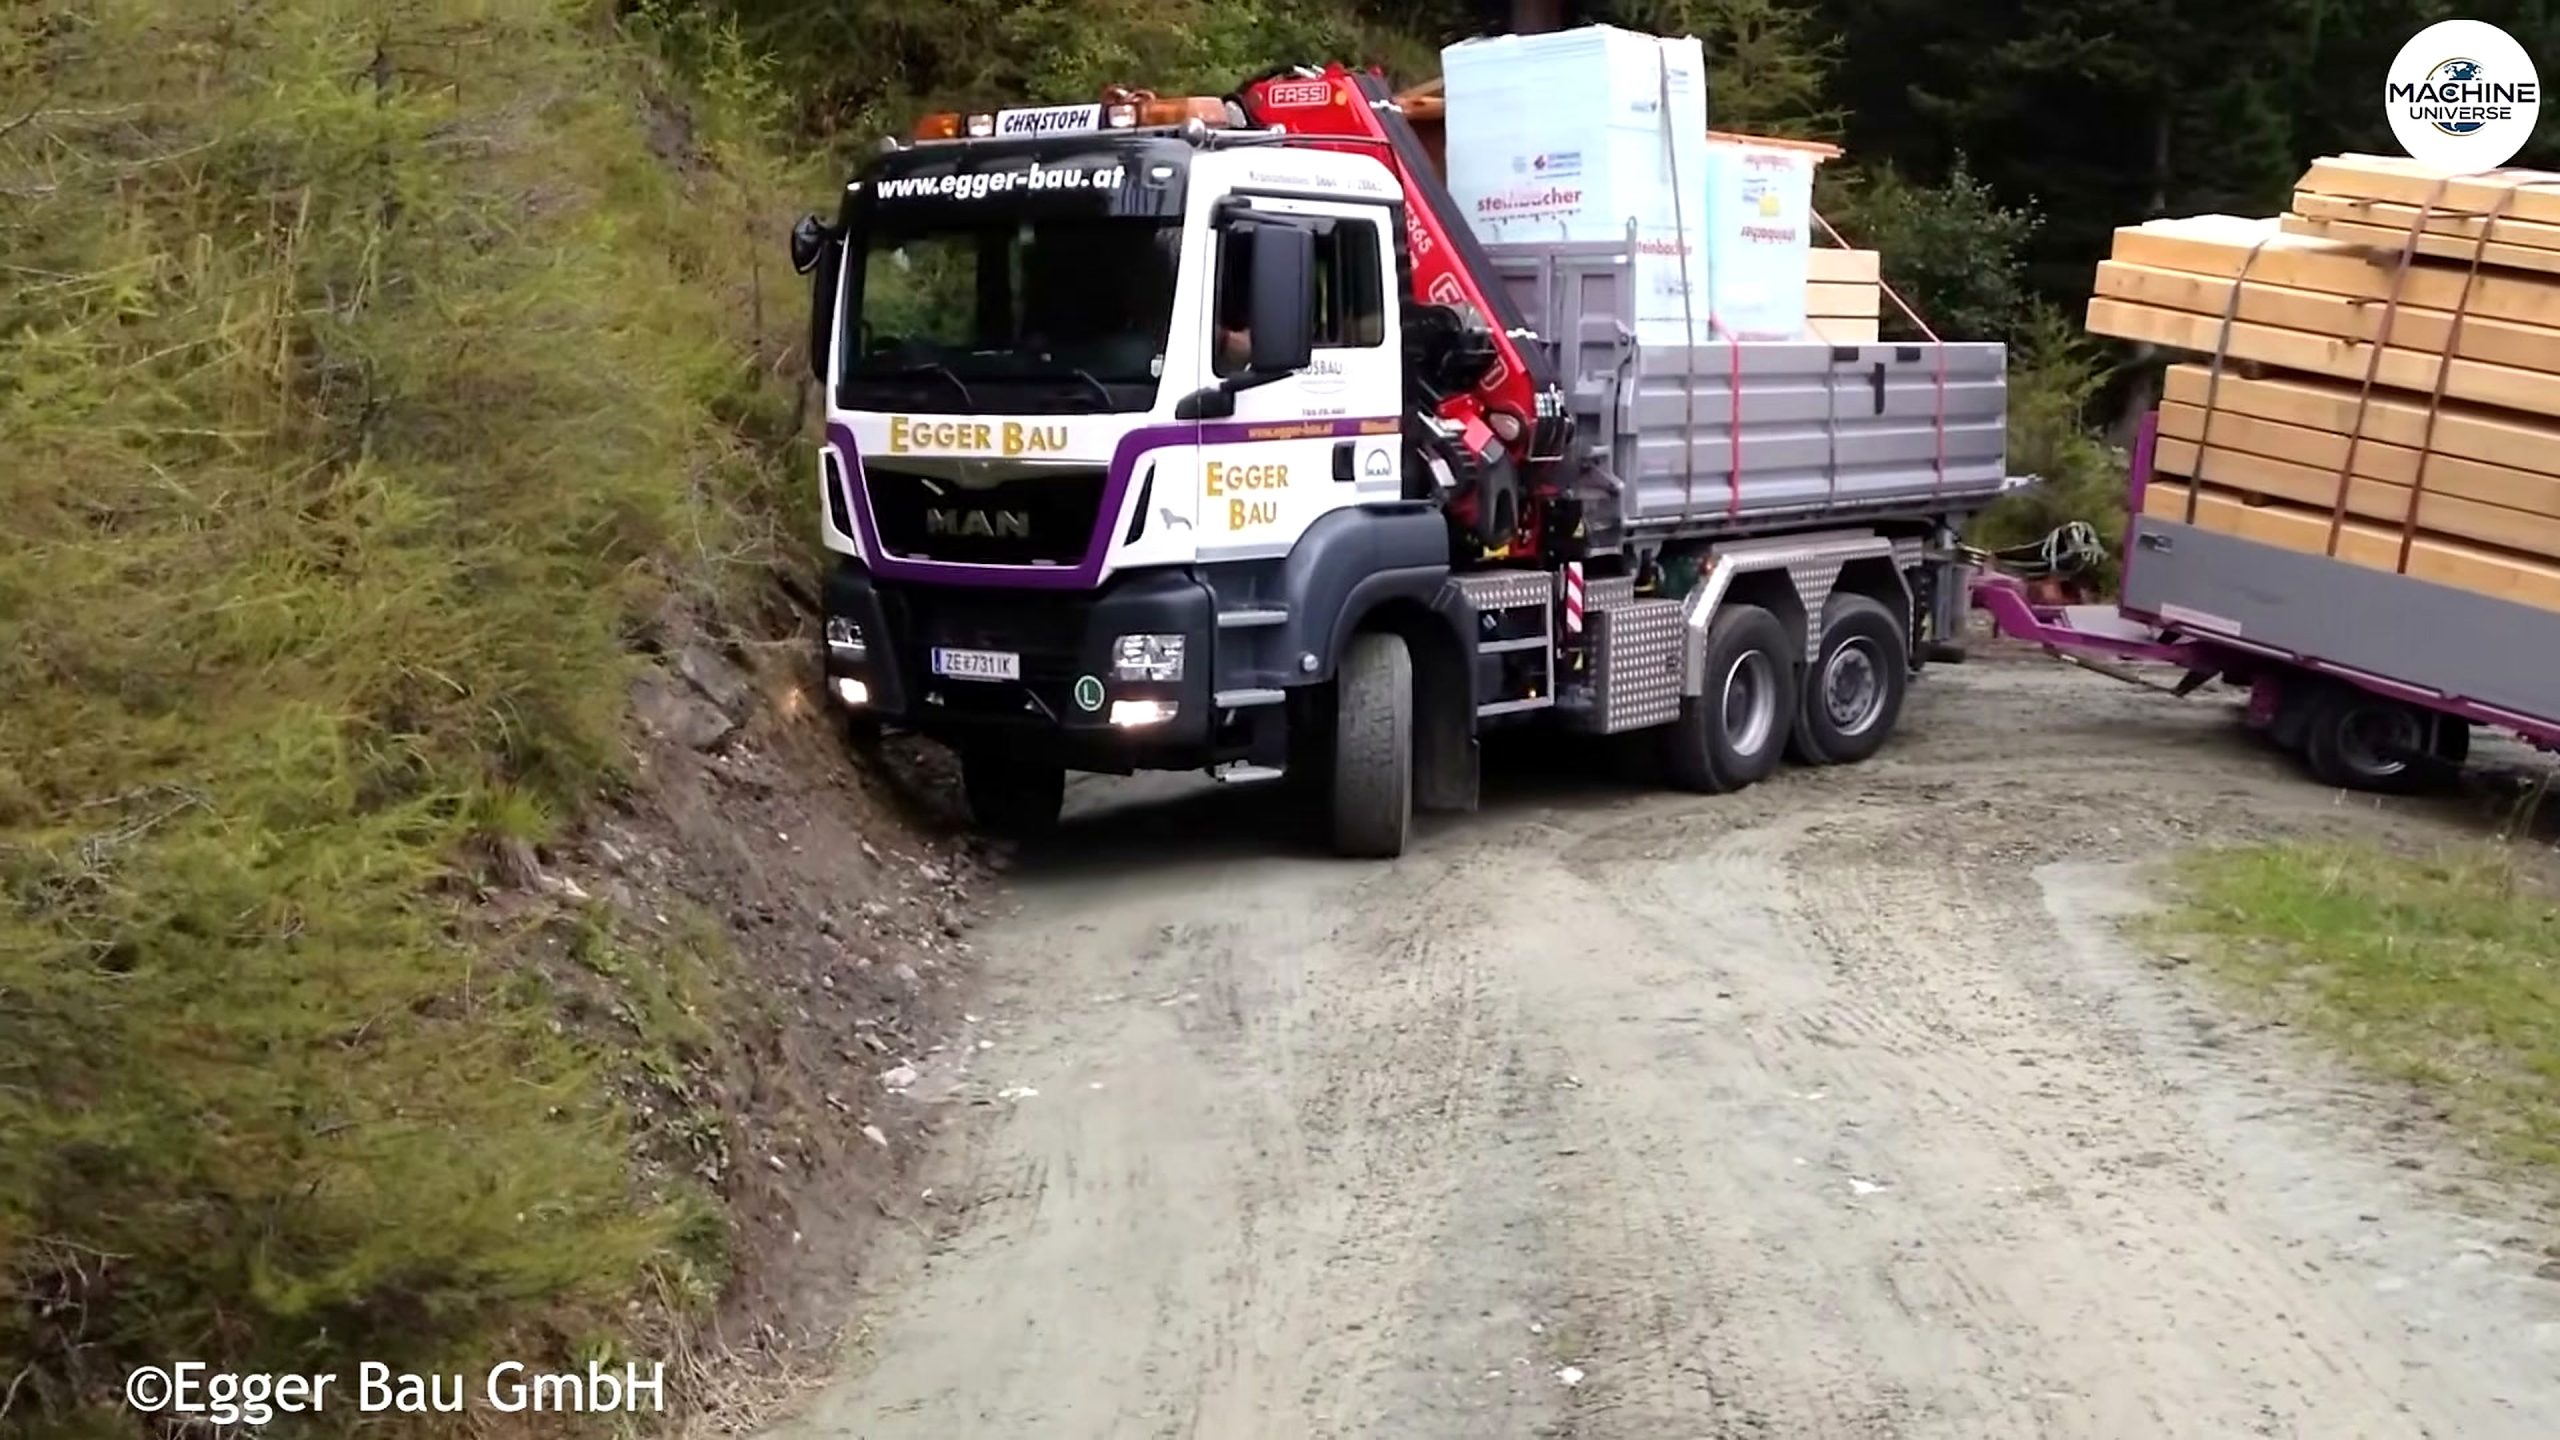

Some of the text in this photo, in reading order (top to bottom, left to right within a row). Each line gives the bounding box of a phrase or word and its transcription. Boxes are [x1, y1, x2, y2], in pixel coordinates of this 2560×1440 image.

[1274, 87, 1325, 102] FASSI
[876, 163, 1127, 200] www.egger-bau.at
[1636, 237, 1692, 256] teinbacr
[891, 416, 1068, 456] EGGER BAU
[1207, 461, 1289, 496] EGGER
[927, 508, 1029, 537] MAN
[1229, 498, 1276, 530] BAU
[1084, 683, 1096, 705] L
